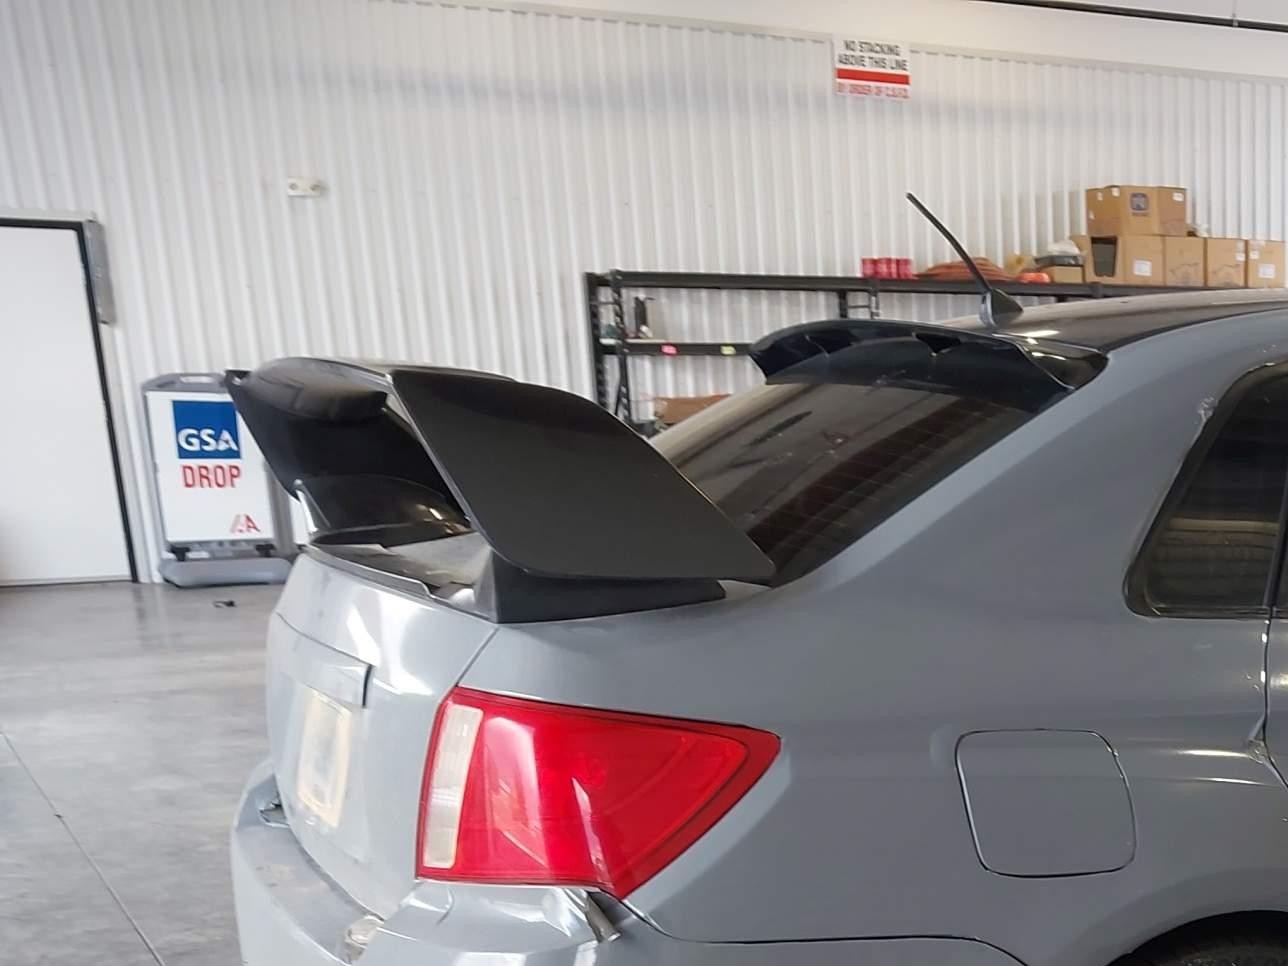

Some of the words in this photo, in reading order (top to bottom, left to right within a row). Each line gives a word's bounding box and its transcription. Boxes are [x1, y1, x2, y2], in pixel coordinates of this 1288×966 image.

[844, 39, 856, 52] NO
[858, 41, 901, 56] STACKING
[838, 53, 866, 67] ABOVE
[868, 56, 887, 69] THIS
[889, 59, 908, 71] LINE
[177, 428, 240, 452] GSA
[181, 464, 242, 489] DROP
